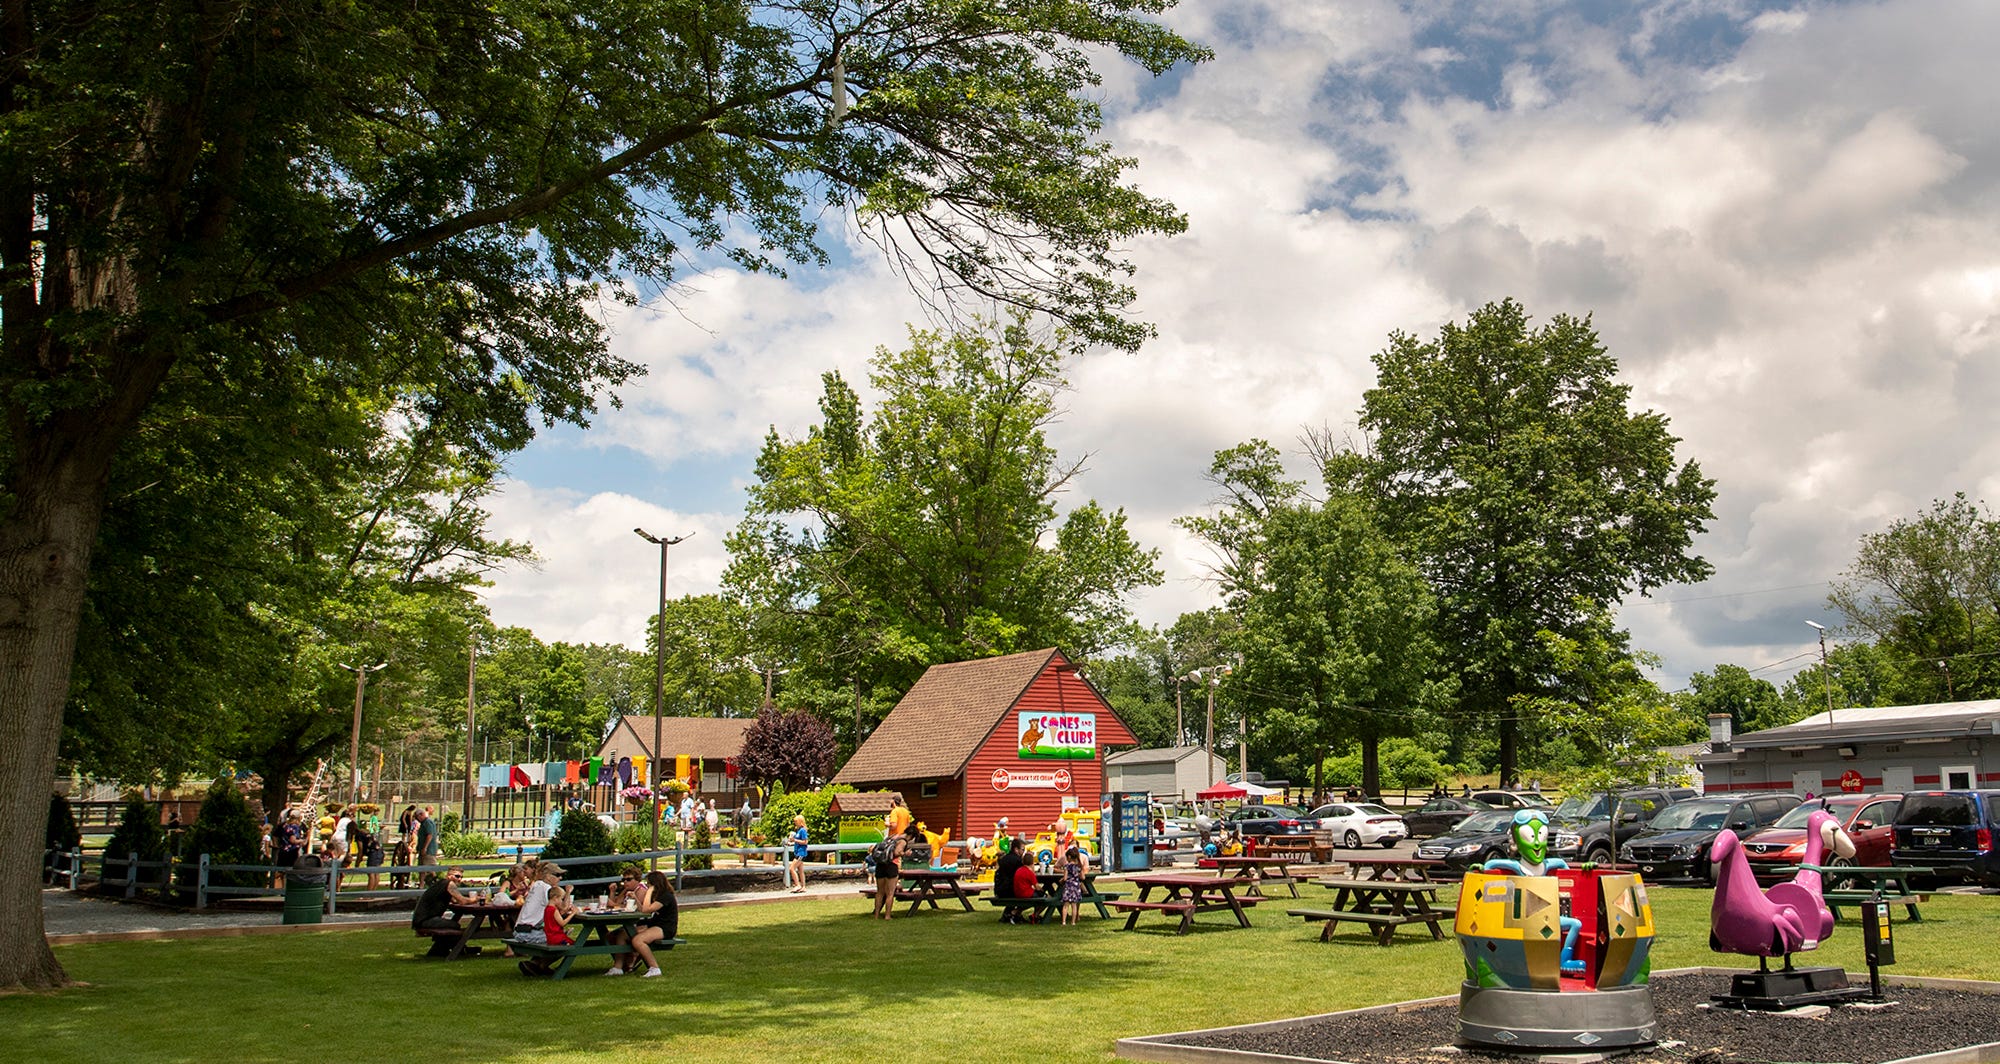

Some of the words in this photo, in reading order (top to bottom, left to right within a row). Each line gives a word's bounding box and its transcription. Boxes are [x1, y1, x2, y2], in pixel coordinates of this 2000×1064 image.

[1040, 716, 1080, 730] CONES
[1057, 731, 1093, 744] CLUBS
[1103, 821, 1111, 867] PEPSI
